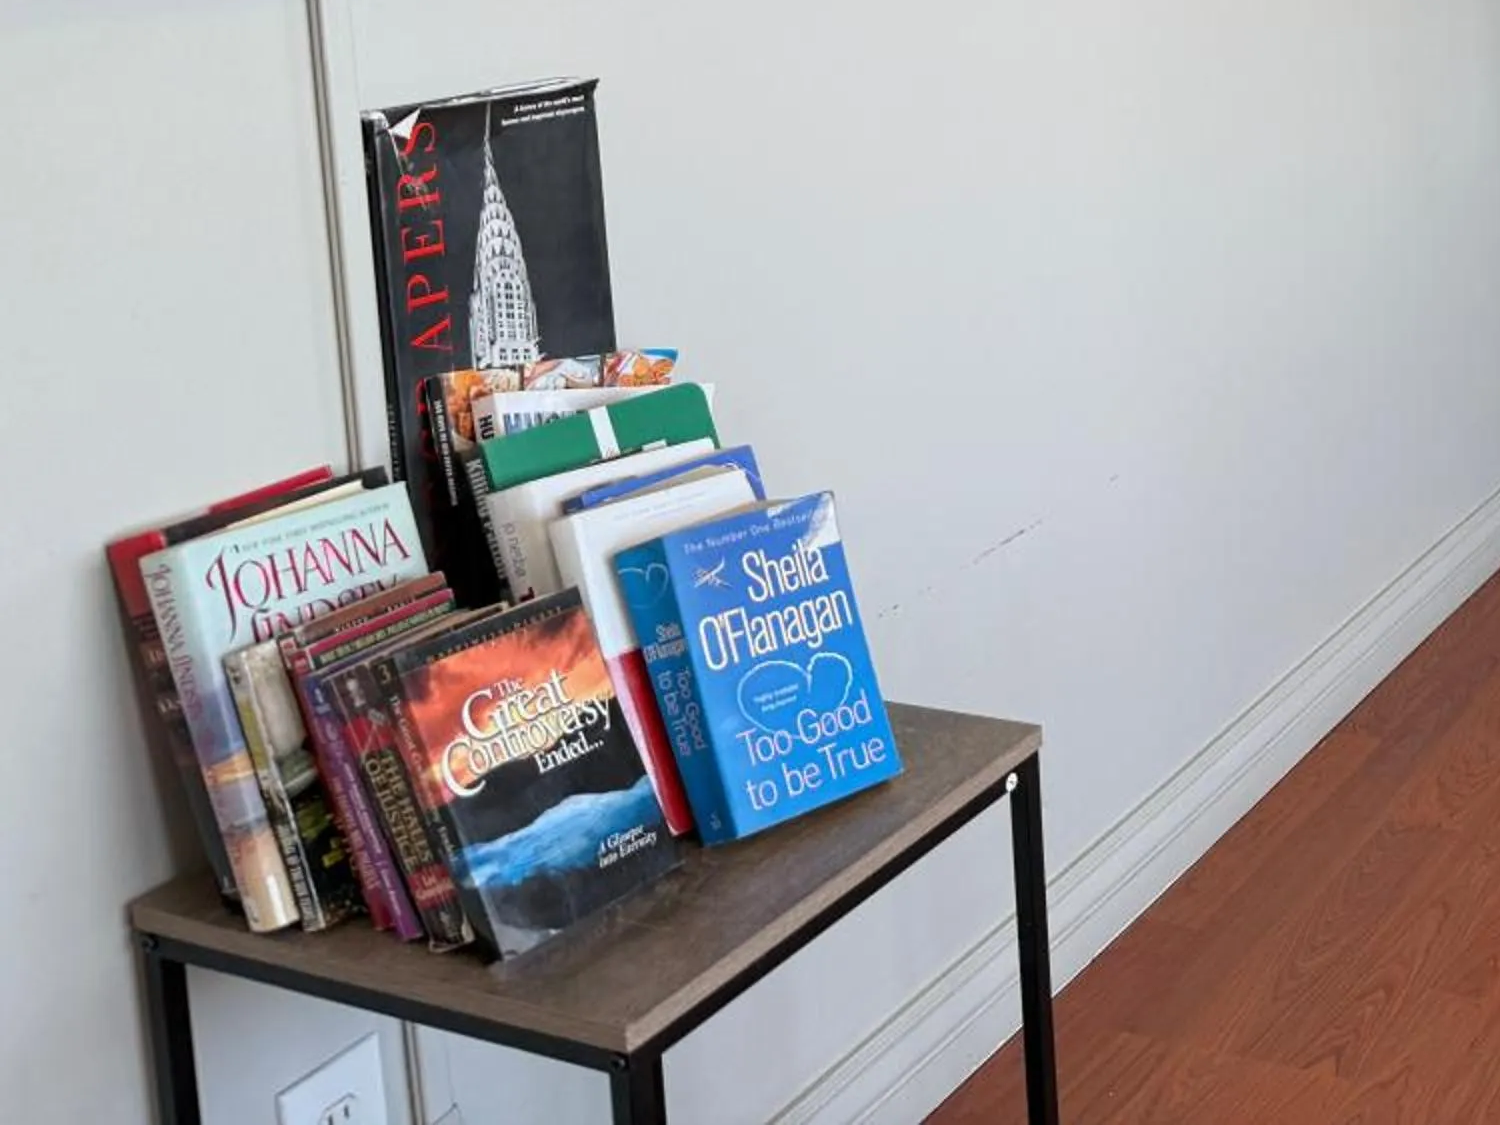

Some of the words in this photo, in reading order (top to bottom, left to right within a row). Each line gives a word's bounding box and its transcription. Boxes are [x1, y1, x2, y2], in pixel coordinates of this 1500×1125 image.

[205, 517, 412, 644] JOHANNA
[741, 537, 830, 602] Sheila
[698, 589, 854, 671] O'Flanagan
[462, 668, 574, 740] Great
[495, 676, 523, 696] The
[440, 689, 616, 798] Controversy
[736, 726, 793, 767] Too
[796, 688, 874, 745] Good
[743, 779, 778, 811] to
[781, 761, 825, 798] be
[816, 736, 888, 780] True
[373, 784, 420, 873] JUSTICE
